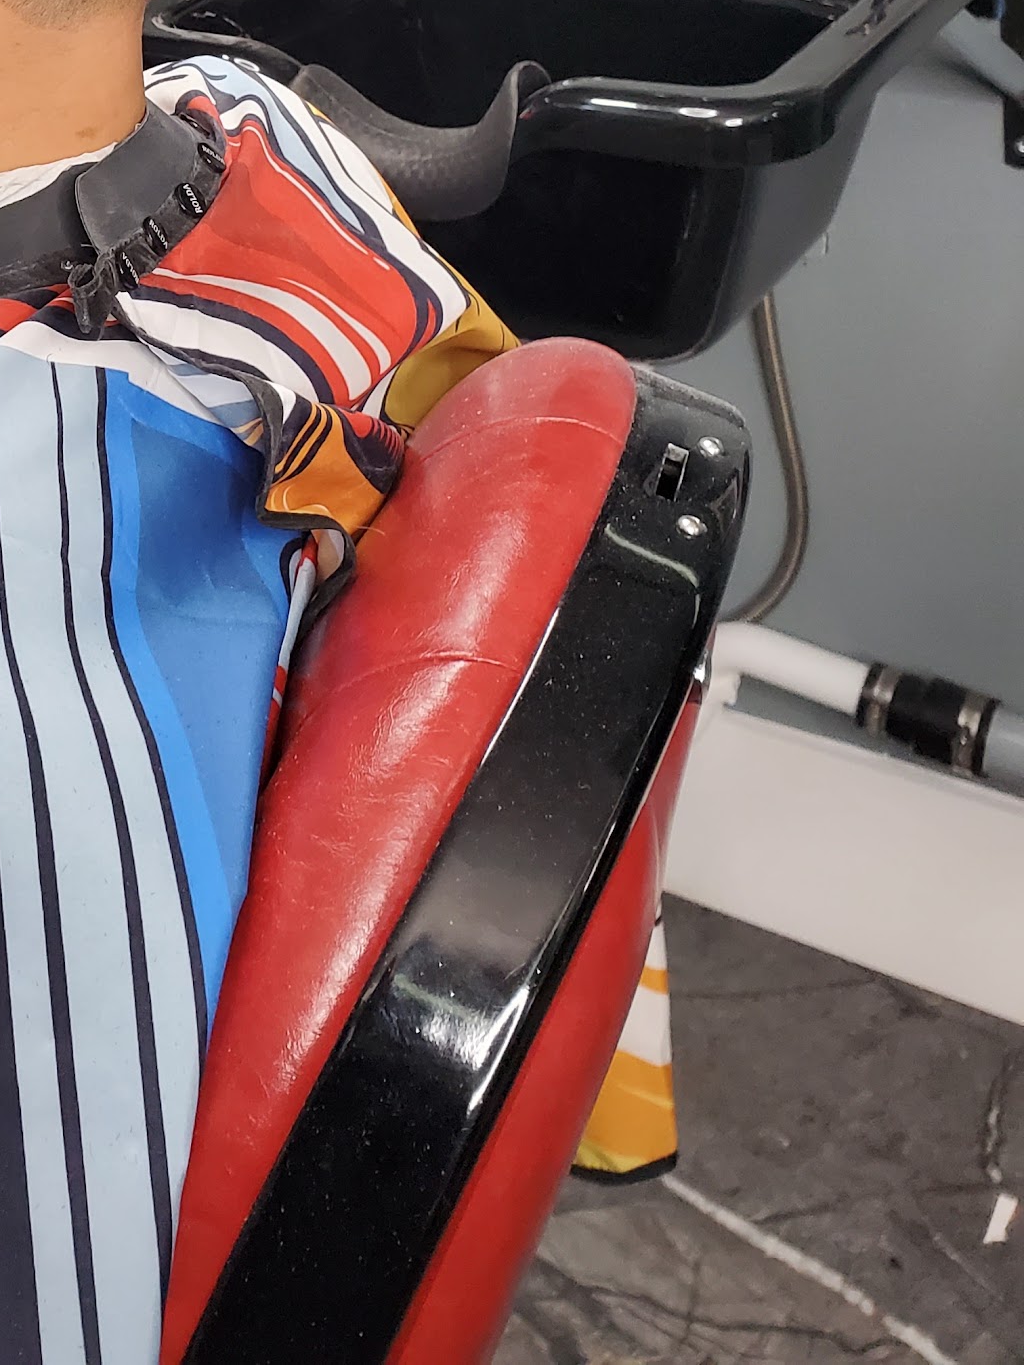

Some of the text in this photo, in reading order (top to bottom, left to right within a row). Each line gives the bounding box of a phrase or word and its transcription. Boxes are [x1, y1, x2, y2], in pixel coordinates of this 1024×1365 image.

[182, 183, 203, 214] ROLDA
[148, 219, 169, 250] ROLDA
[122, 251, 140, 284] ROLDA
